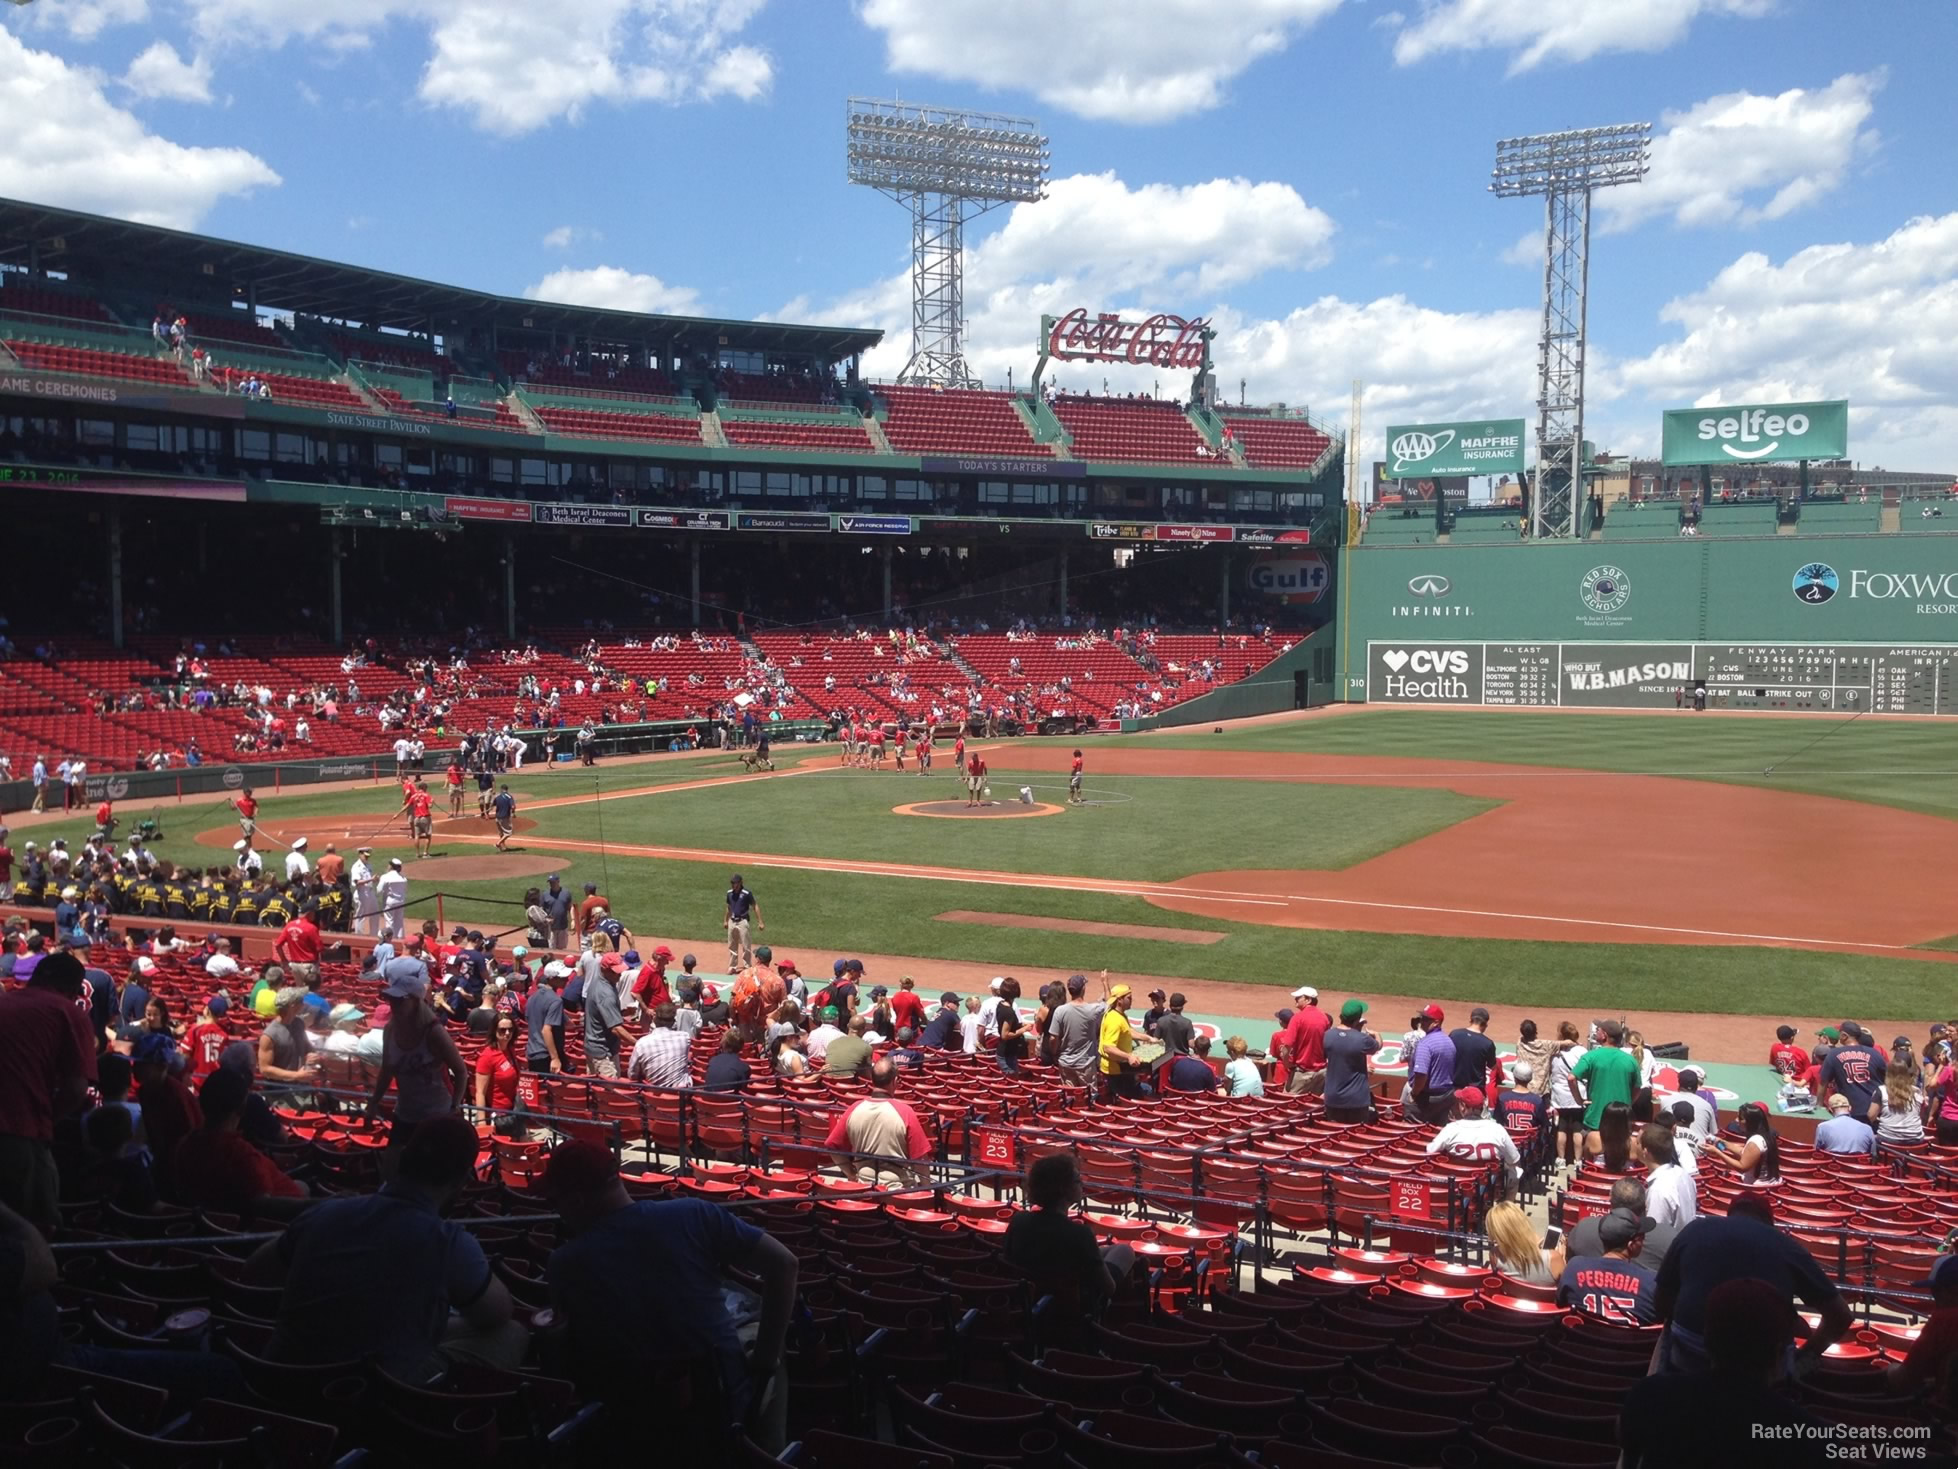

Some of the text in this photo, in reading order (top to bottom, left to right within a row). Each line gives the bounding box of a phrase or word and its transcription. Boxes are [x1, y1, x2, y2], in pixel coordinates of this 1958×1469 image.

[1050, 308, 1212, 369] Coca-Cola
[36, 380, 116, 400] CEREMONIES
[328, 412, 430, 434] STATE STREET PAVILION
[1397, 434, 1431, 459] AAA
[1461, 436, 1518, 448] MAPFRE
[1464, 450, 1514, 460] INSURANCE
[958, 460, 1048, 472] TODAY'S STARTERS
[552, 507, 569, 515] Beth
[592, 510, 628, 518] Deaconess
[552, 515, 581, 523] Medical
[752, 519, 785, 527] Barracuda
[1000, 525, 1010, 533] VS
[1094, 526, 1118, 536] Tribe
[1171, 529, 1190, 537] Ninety
[1242, 534, 1274, 542] Safelite
[1252, 566, 1324, 588] Gulf
[1584, 568, 1622, 588] RED SOX
[1585, 584, 1628, 610] SCHOLARS
[1392, 606, 1469, 616] INFINITI
[1410, 650, 1468, 673] CVS
[1585, 664, 1601, 672] BUT
[1350, 679, 1364, 688] 310
[1570, 662, 1690, 690] W.B.MASON
[1385, 675, 1469, 698] Health
[205, 1043, 220, 1062] 15
[1776, 1059, 1796, 1076] 34
[1843, 1062, 1870, 1083] 15
[1507, 1113, 1532, 1129] 15
[987, 1145, 1007, 1158] 23
[1455, 1143, 1497, 1160] 20
[1399, 1197, 1422, 1210] 22
[1577, 1270, 1639, 1294] PEDROIA
[1583, 1293, 1639, 1326] 15
